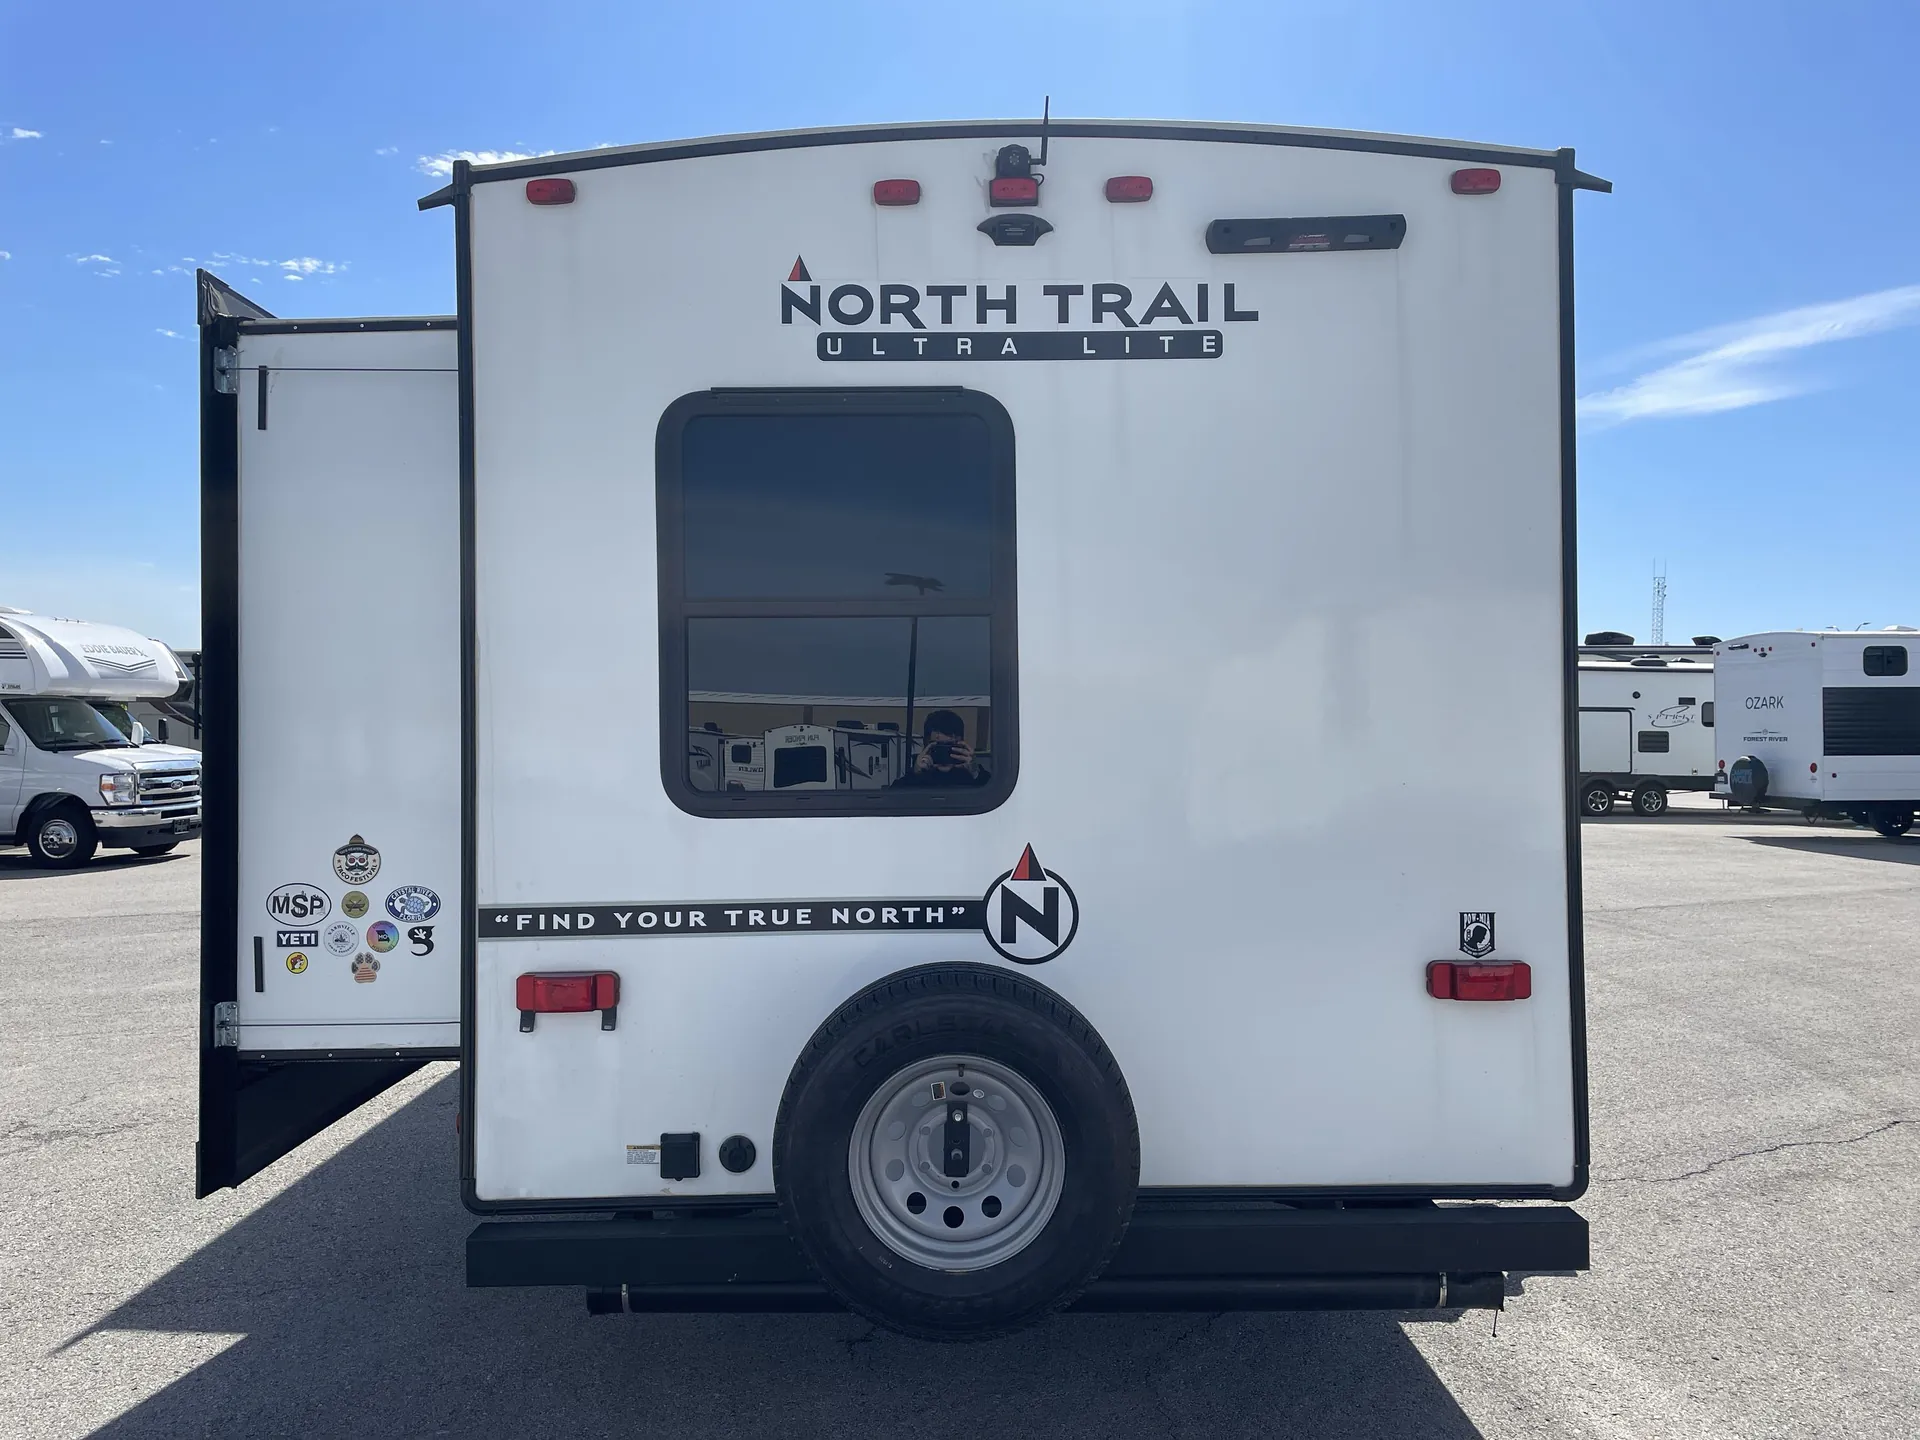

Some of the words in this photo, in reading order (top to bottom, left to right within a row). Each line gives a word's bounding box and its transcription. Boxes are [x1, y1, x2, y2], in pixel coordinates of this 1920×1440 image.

[780, 282, 1017, 329] NORTH
[1042, 281, 1259, 328] TRAIL
[825, 337, 1018, 356] ULTRA
[1083, 335, 1217, 354] LITE
[82, 644, 110, 654] EDDIE
[108, 645, 138, 656] BAUER
[1745, 695, 1784, 710] OZARK
[337, 865, 350, 880] TACO
[350, 864, 378, 882] FESTIVAL
[391, 887, 416, 900] CRYSTAL
[416, 887, 434, 898] RIVER
[271, 893, 325, 919] MSP
[399, 913, 426, 921] FLORIDA
[613, 910, 708, 929] YOUR
[724, 908, 812, 927] TRUE
[1000, 883, 1060, 948] N
[278, 933, 316, 945] YETI
